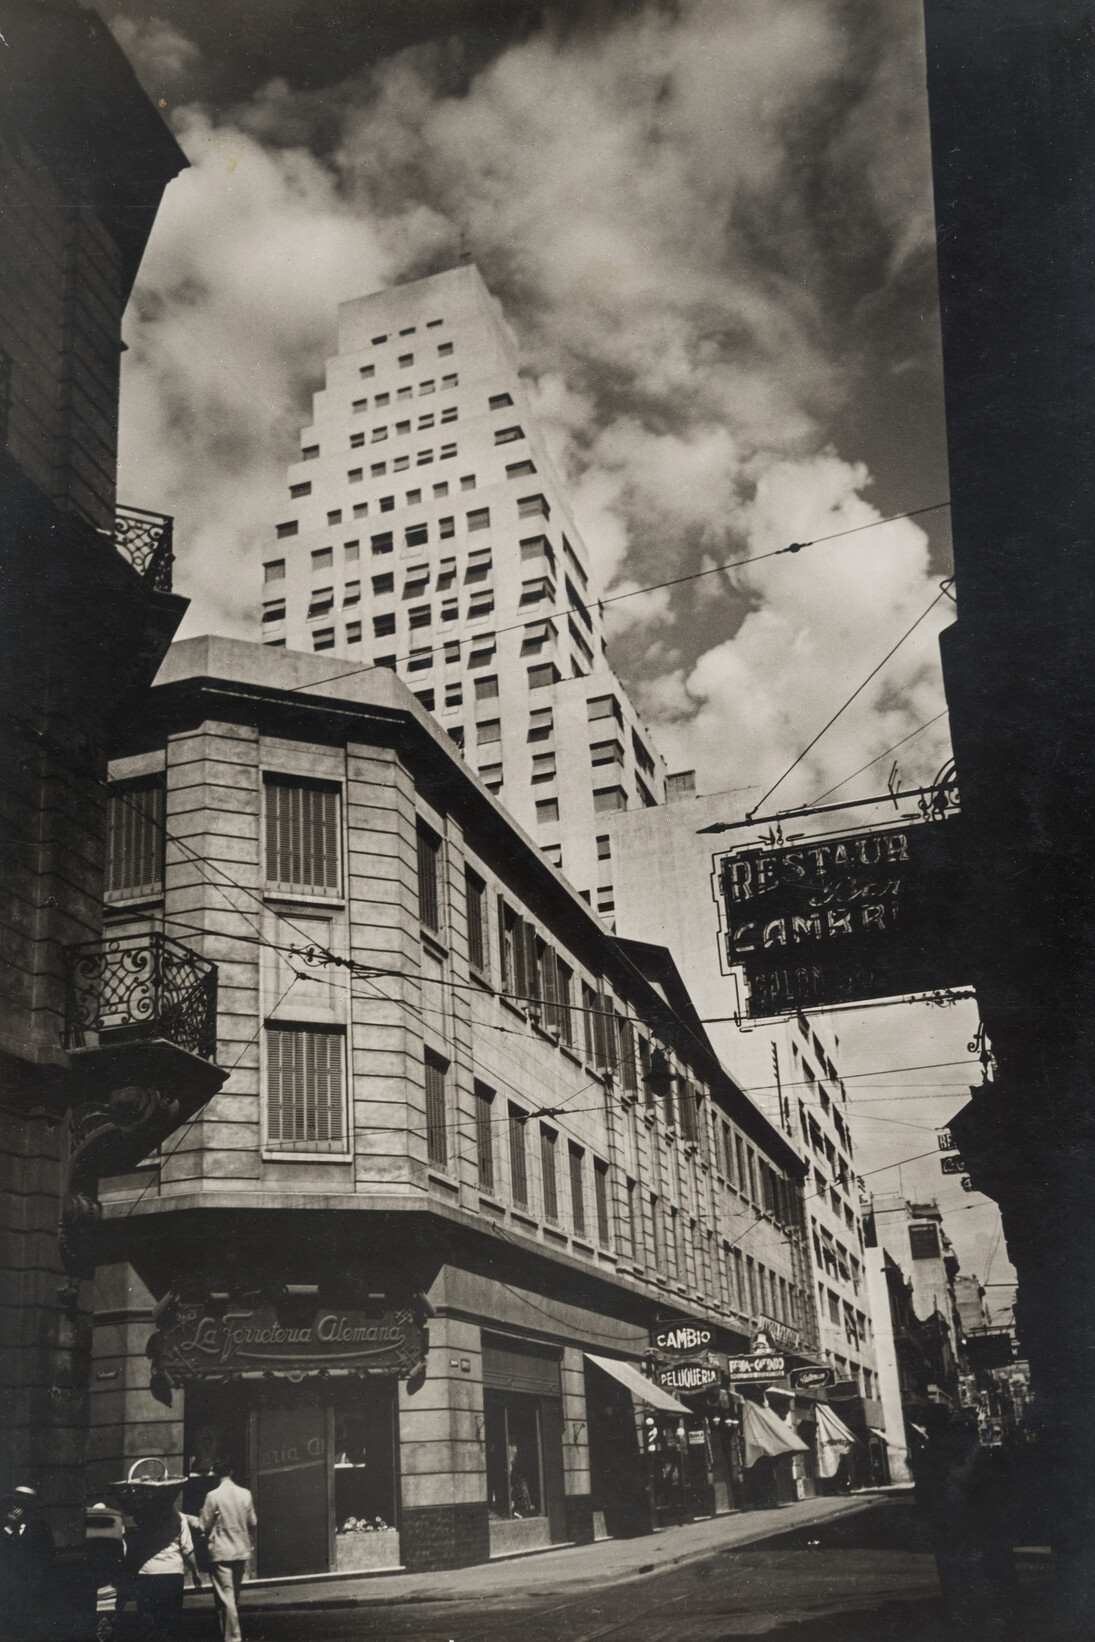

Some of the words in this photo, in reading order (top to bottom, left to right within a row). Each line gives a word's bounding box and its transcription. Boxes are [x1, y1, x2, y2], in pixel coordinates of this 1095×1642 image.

[940, 1134, 957, 1150] BE
[180, 1316, 220, 1354] La
[316, 1314, 404, 1344] Alemana
[656, 1327, 711, 1349] CAMBIO
[660, 1367, 717, 1388] PELUQUERIA
